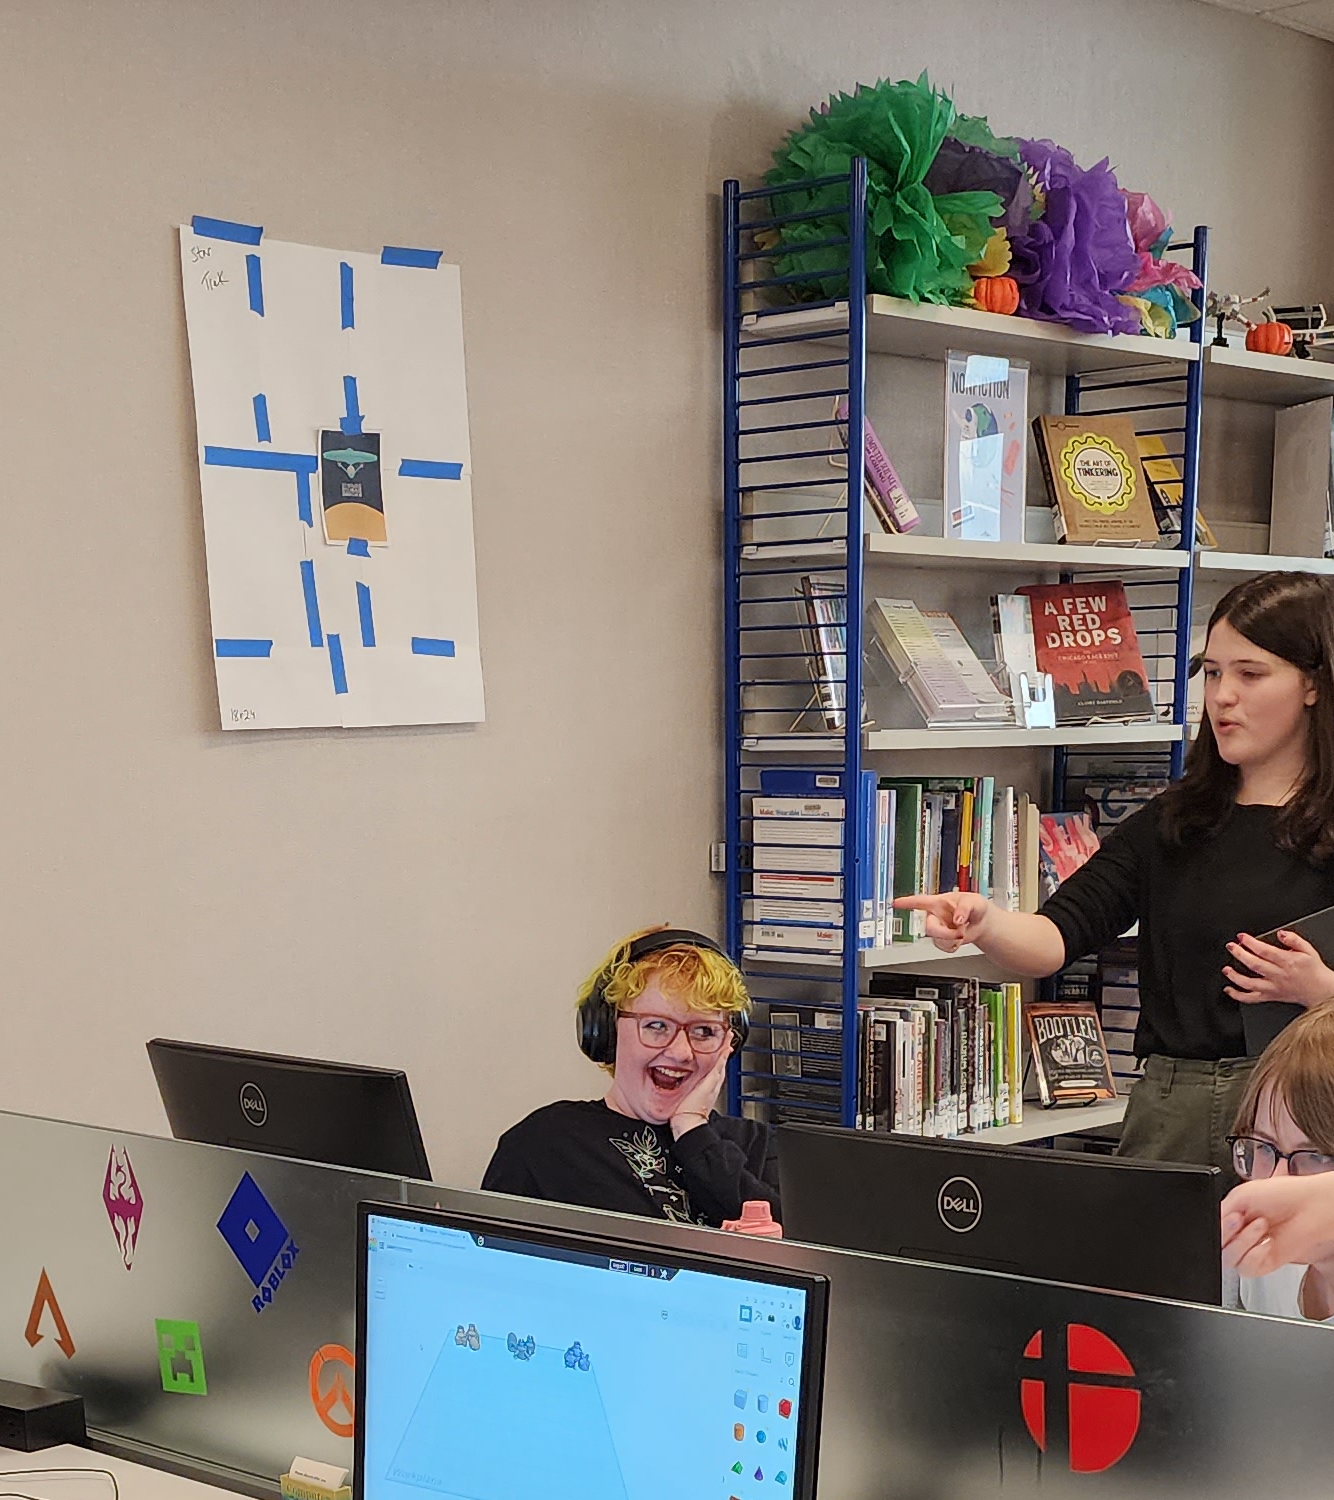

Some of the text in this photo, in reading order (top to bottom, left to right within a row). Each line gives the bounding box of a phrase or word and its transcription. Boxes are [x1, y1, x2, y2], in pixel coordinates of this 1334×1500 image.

[1076, 466, 1119, 478] TINKERING
[1079, 459, 1112, 467] THE ART OF
[1044, 595, 1107, 616] A FEW
[1056, 613, 1101, 631] RED
[1046, 627, 1122, 649] DROPS
[1034, 1016, 1098, 1045] BOOTLEG
[960, 1031, 968, 1070] RADIUM
[243, 1097, 264, 1112] DELL
[943, 1194, 978, 1216] DELL
[251, 1239, 300, 1314] ROBLOX
[391, 1467, 444, 1487] Workplane
